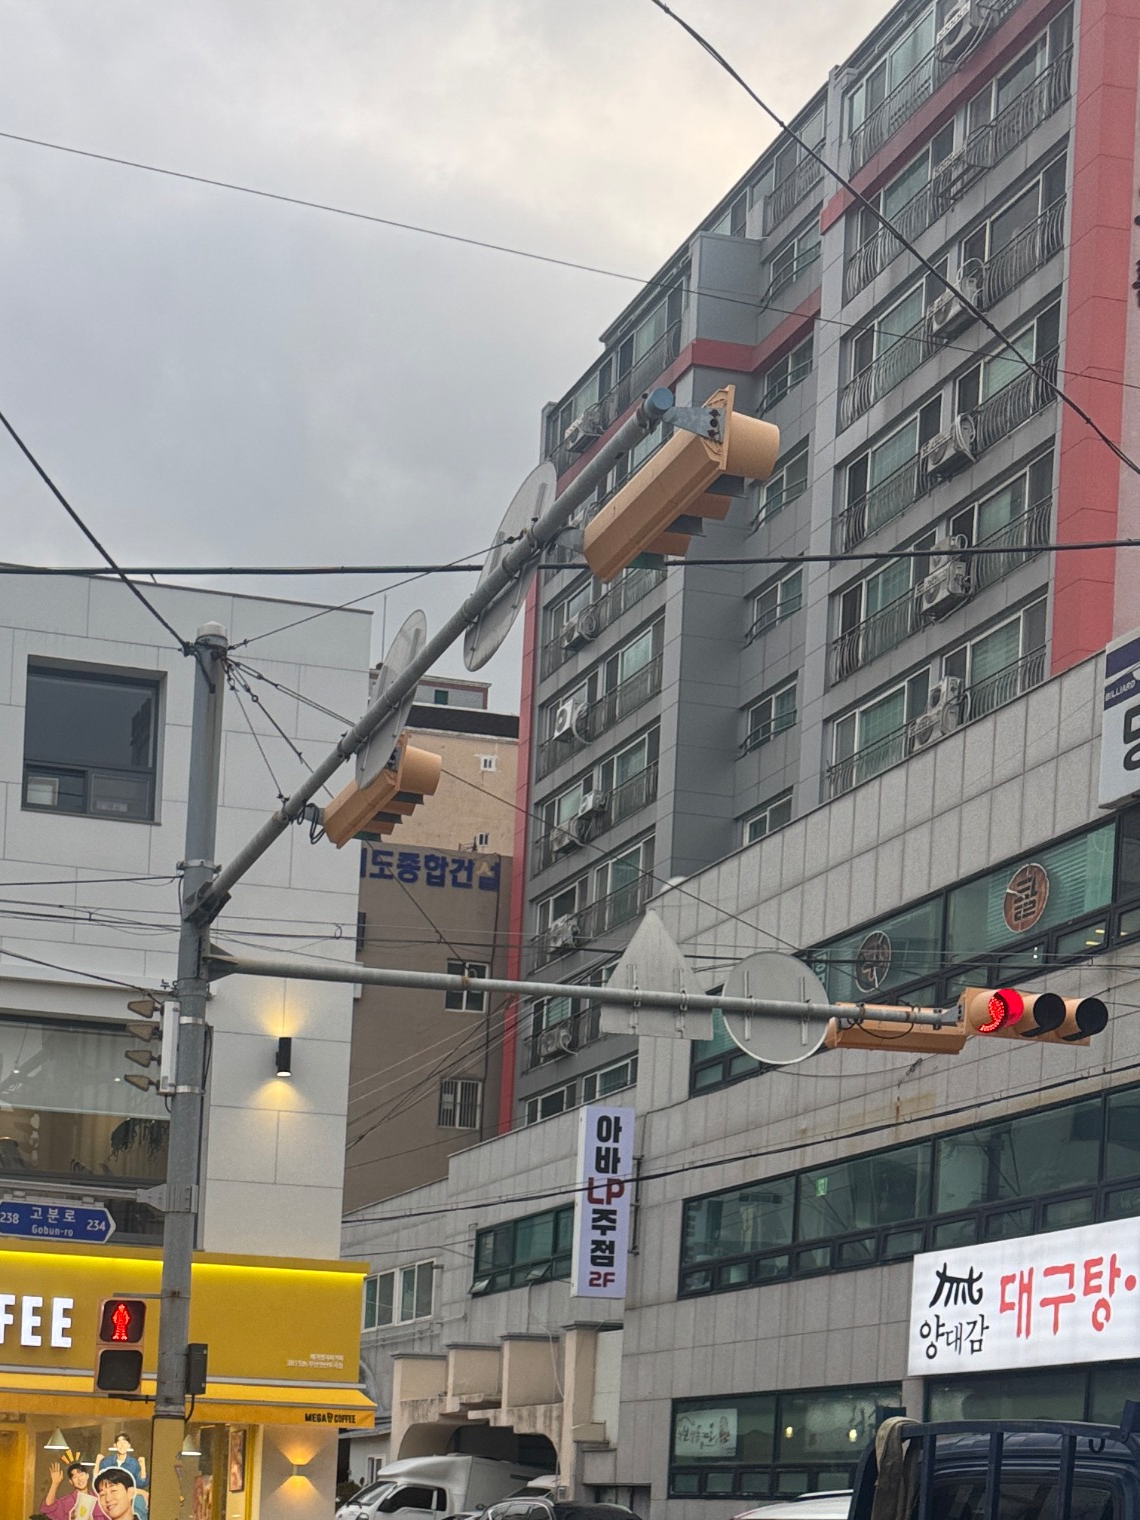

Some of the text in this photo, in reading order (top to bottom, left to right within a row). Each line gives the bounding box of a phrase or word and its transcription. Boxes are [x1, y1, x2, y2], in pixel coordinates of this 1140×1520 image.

[0, 1211, 20, 1224] 238
[29, 1206, 77, 1224] 고분로
[31, 1224, 74, 1237] Gobun-ro
[86, 1219, 106, 1232] 234
[588, 1271, 616, 1288] 2F
[920, 1314, 990, 1360] 양대감
[304, 1412, 327, 1423] MEGA
